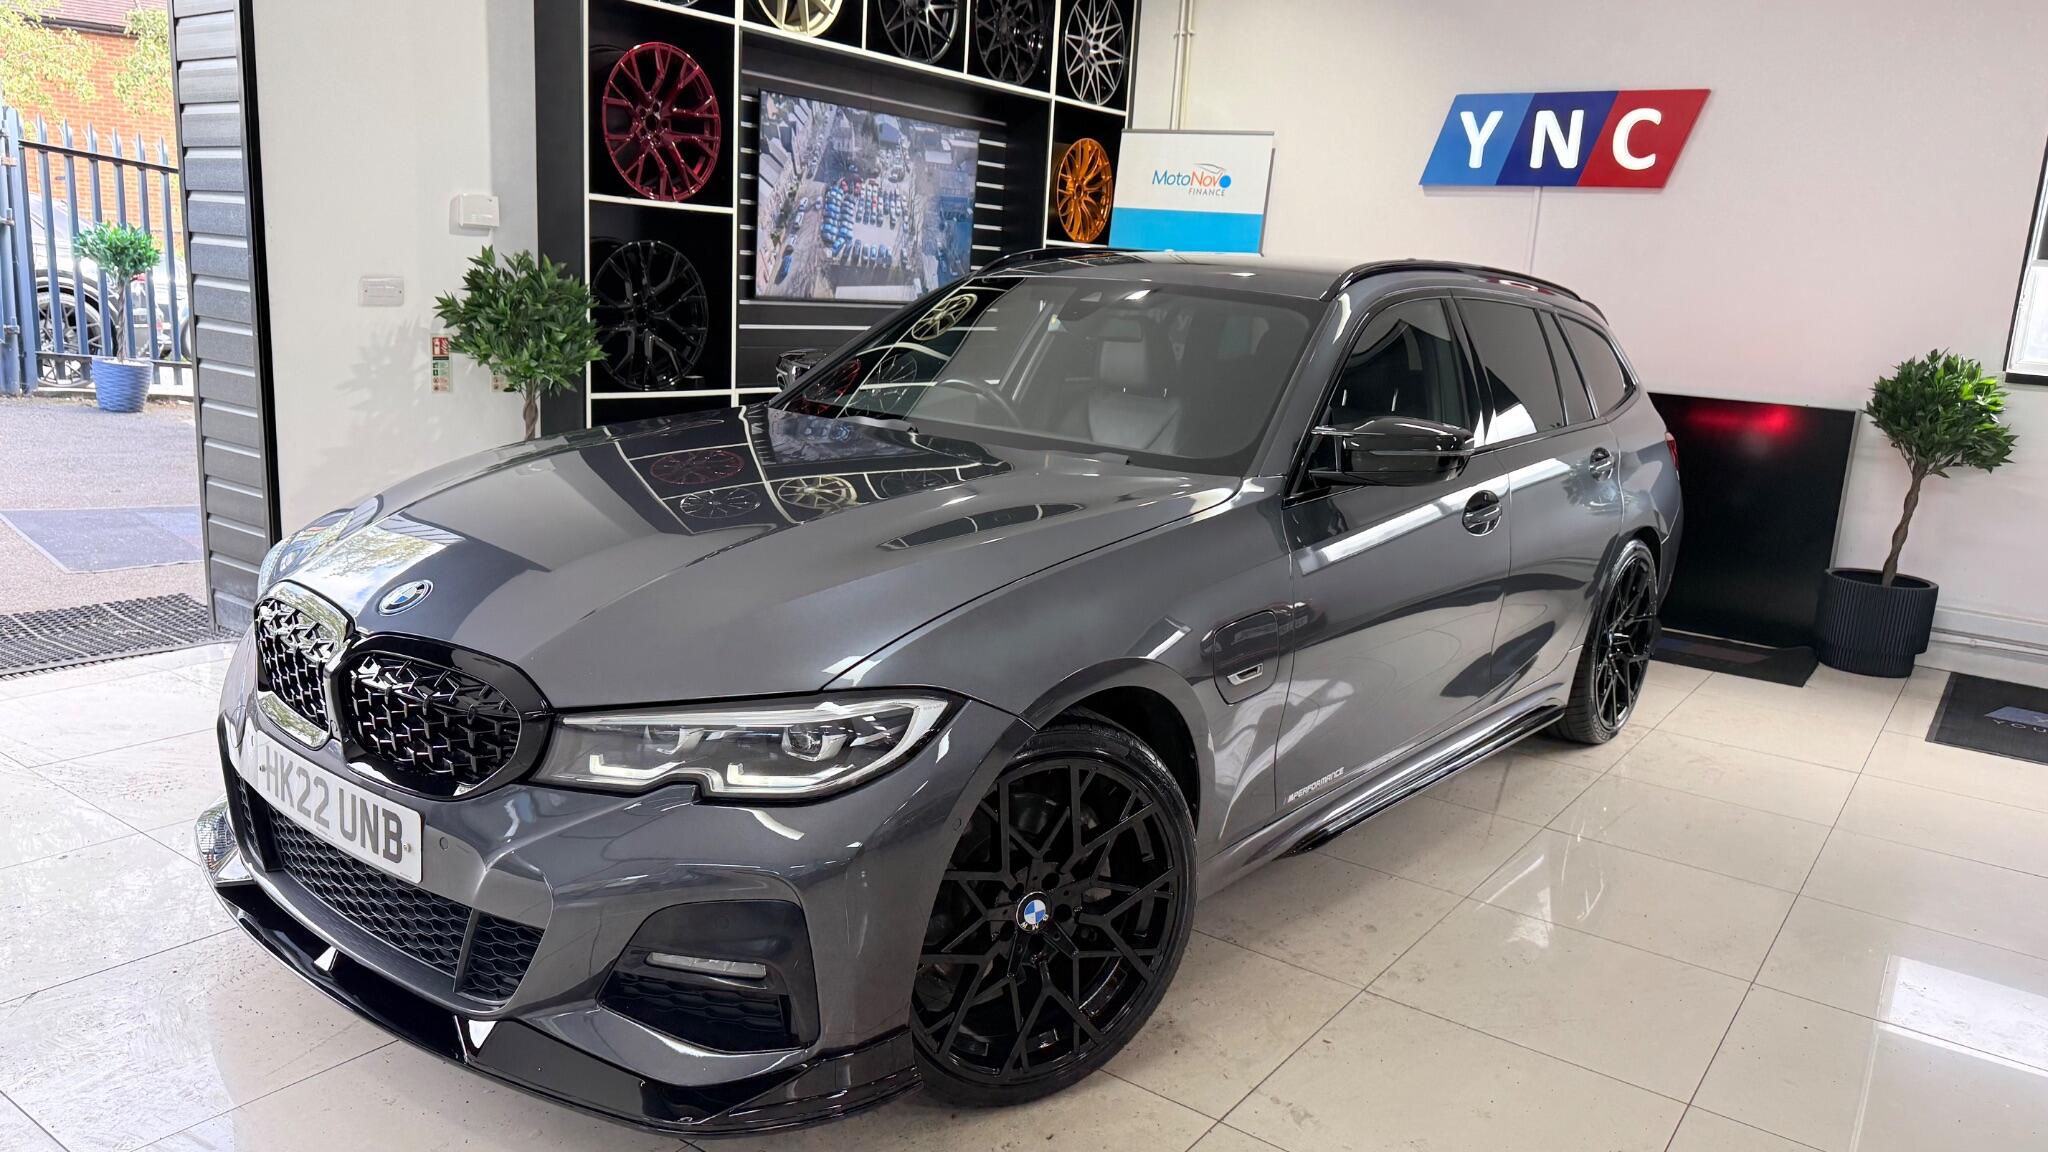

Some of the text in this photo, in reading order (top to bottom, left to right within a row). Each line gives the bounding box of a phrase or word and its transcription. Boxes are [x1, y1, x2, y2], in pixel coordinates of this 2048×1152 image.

[1460, 108, 1662, 170] YNC
[1189, 187, 1226, 197] FINANCE
[265, 745, 403, 864] HK22 UNB
